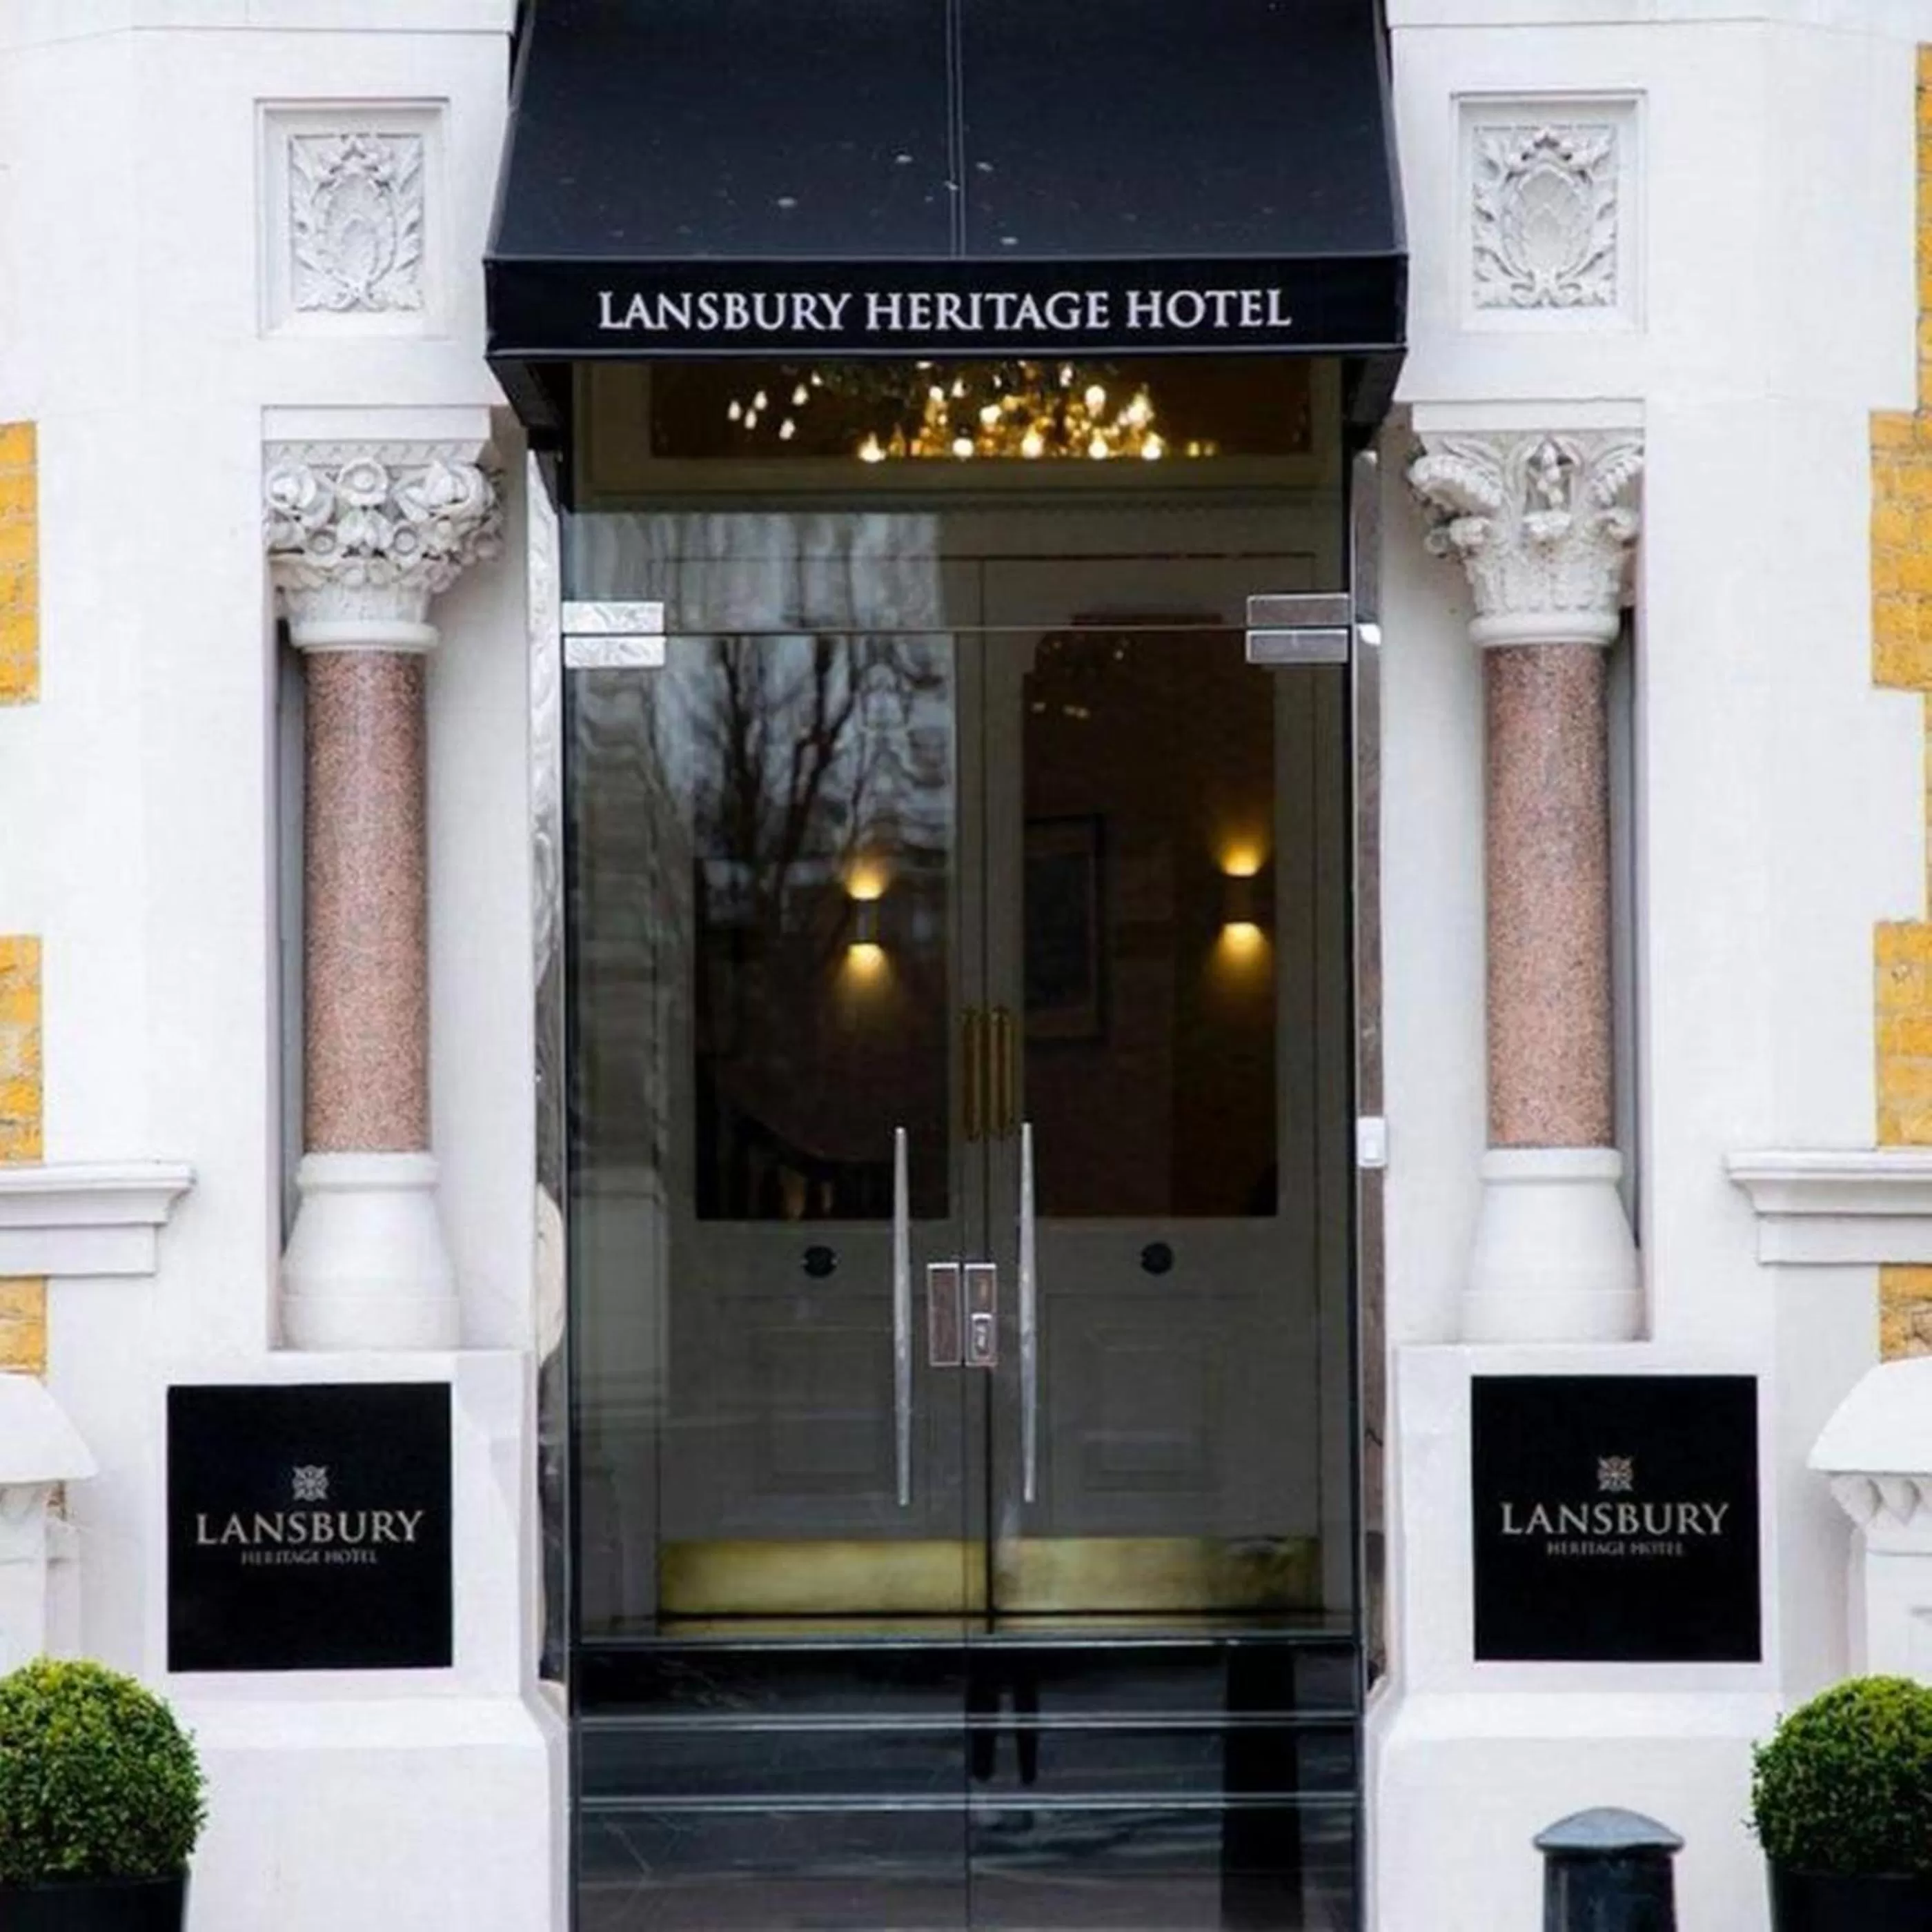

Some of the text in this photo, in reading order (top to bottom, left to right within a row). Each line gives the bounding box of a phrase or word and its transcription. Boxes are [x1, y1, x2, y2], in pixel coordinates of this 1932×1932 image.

[598, 288, 1292, 331] LANSBURY HERITAGE HOTEL
[196, 1509, 424, 1544] LANSBURY
[1500, 1501, 1730, 1535] LANSBURY
[241, 1548, 377, 1566] HERITAGE HOTEL
